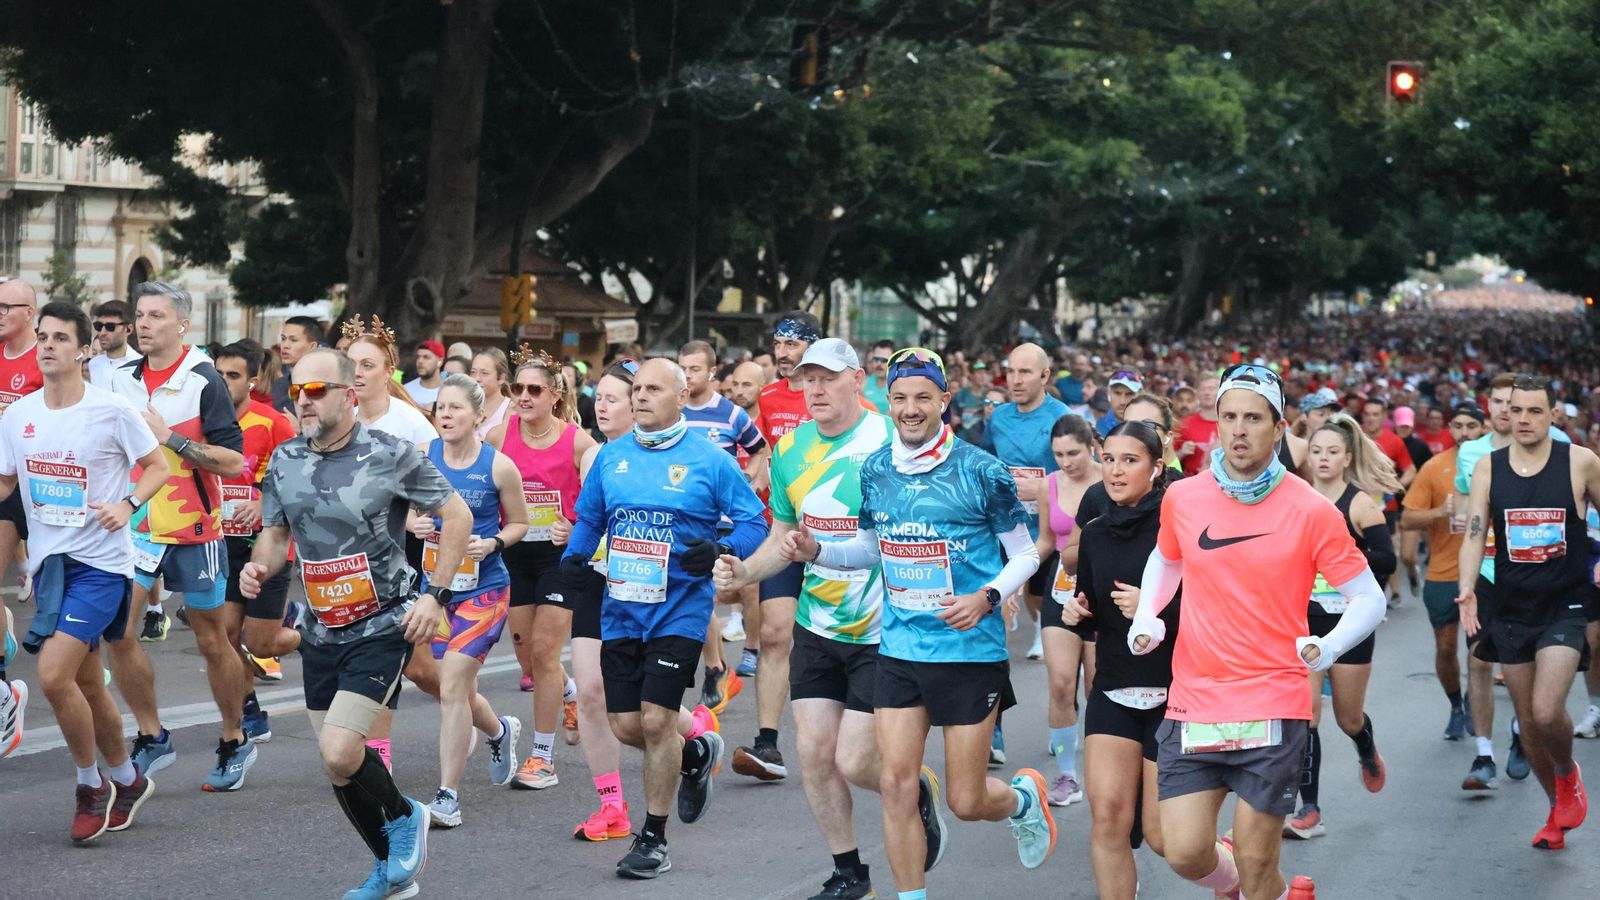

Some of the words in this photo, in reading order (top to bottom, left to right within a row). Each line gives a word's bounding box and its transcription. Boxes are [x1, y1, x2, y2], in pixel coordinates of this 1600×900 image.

[39, 463, 83, 478] GENERALI
[35, 483, 73, 498] 17803
[615, 508, 648, 523] ORO
[652, 511, 673, 526] DE
[1522, 511, 1561, 520] GENERALI
[891, 522, 939, 538] MEDIA
[621, 542, 663, 555] GENERALI
[892, 544, 941, 557] GENERALI
[313, 557, 362, 575] GENERALI
[617, 560, 651, 575] 12766
[892, 566, 933, 580] 16007
[317, 582, 353, 598] 7420
[1173, 706, 1187, 714] TEAM
[533, 743, 550, 752] SRC
[597, 786, 618, 796] SRC
